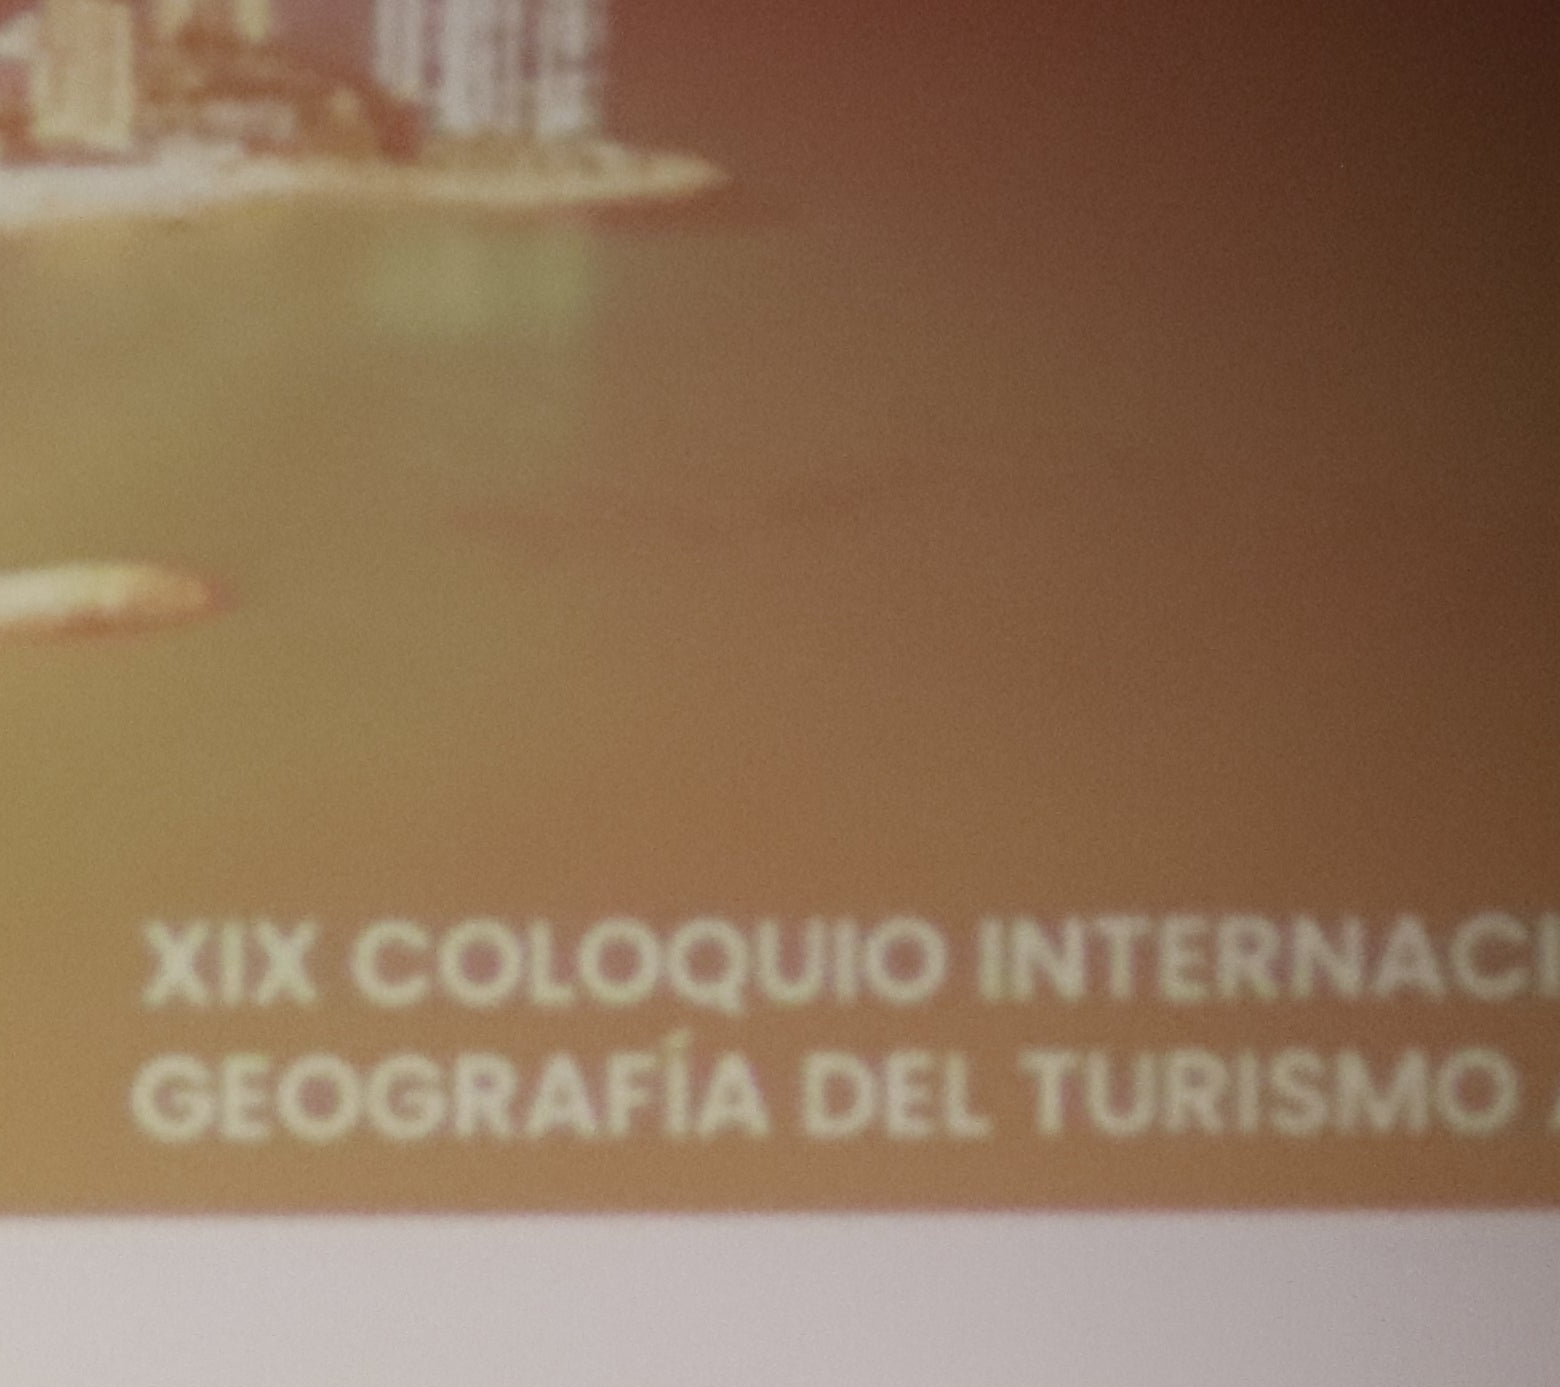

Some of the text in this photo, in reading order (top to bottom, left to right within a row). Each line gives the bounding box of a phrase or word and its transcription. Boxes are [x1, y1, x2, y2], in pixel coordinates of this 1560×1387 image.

[142, 911, 1560, 1016] XIX COLOQUIO INTERNACI
[131, 1028, 770, 1141] GEOGRAFÍA
[802, 1047, 990, 1139] DEL
[1020, 1046, 1520, 1138] TURISMO
